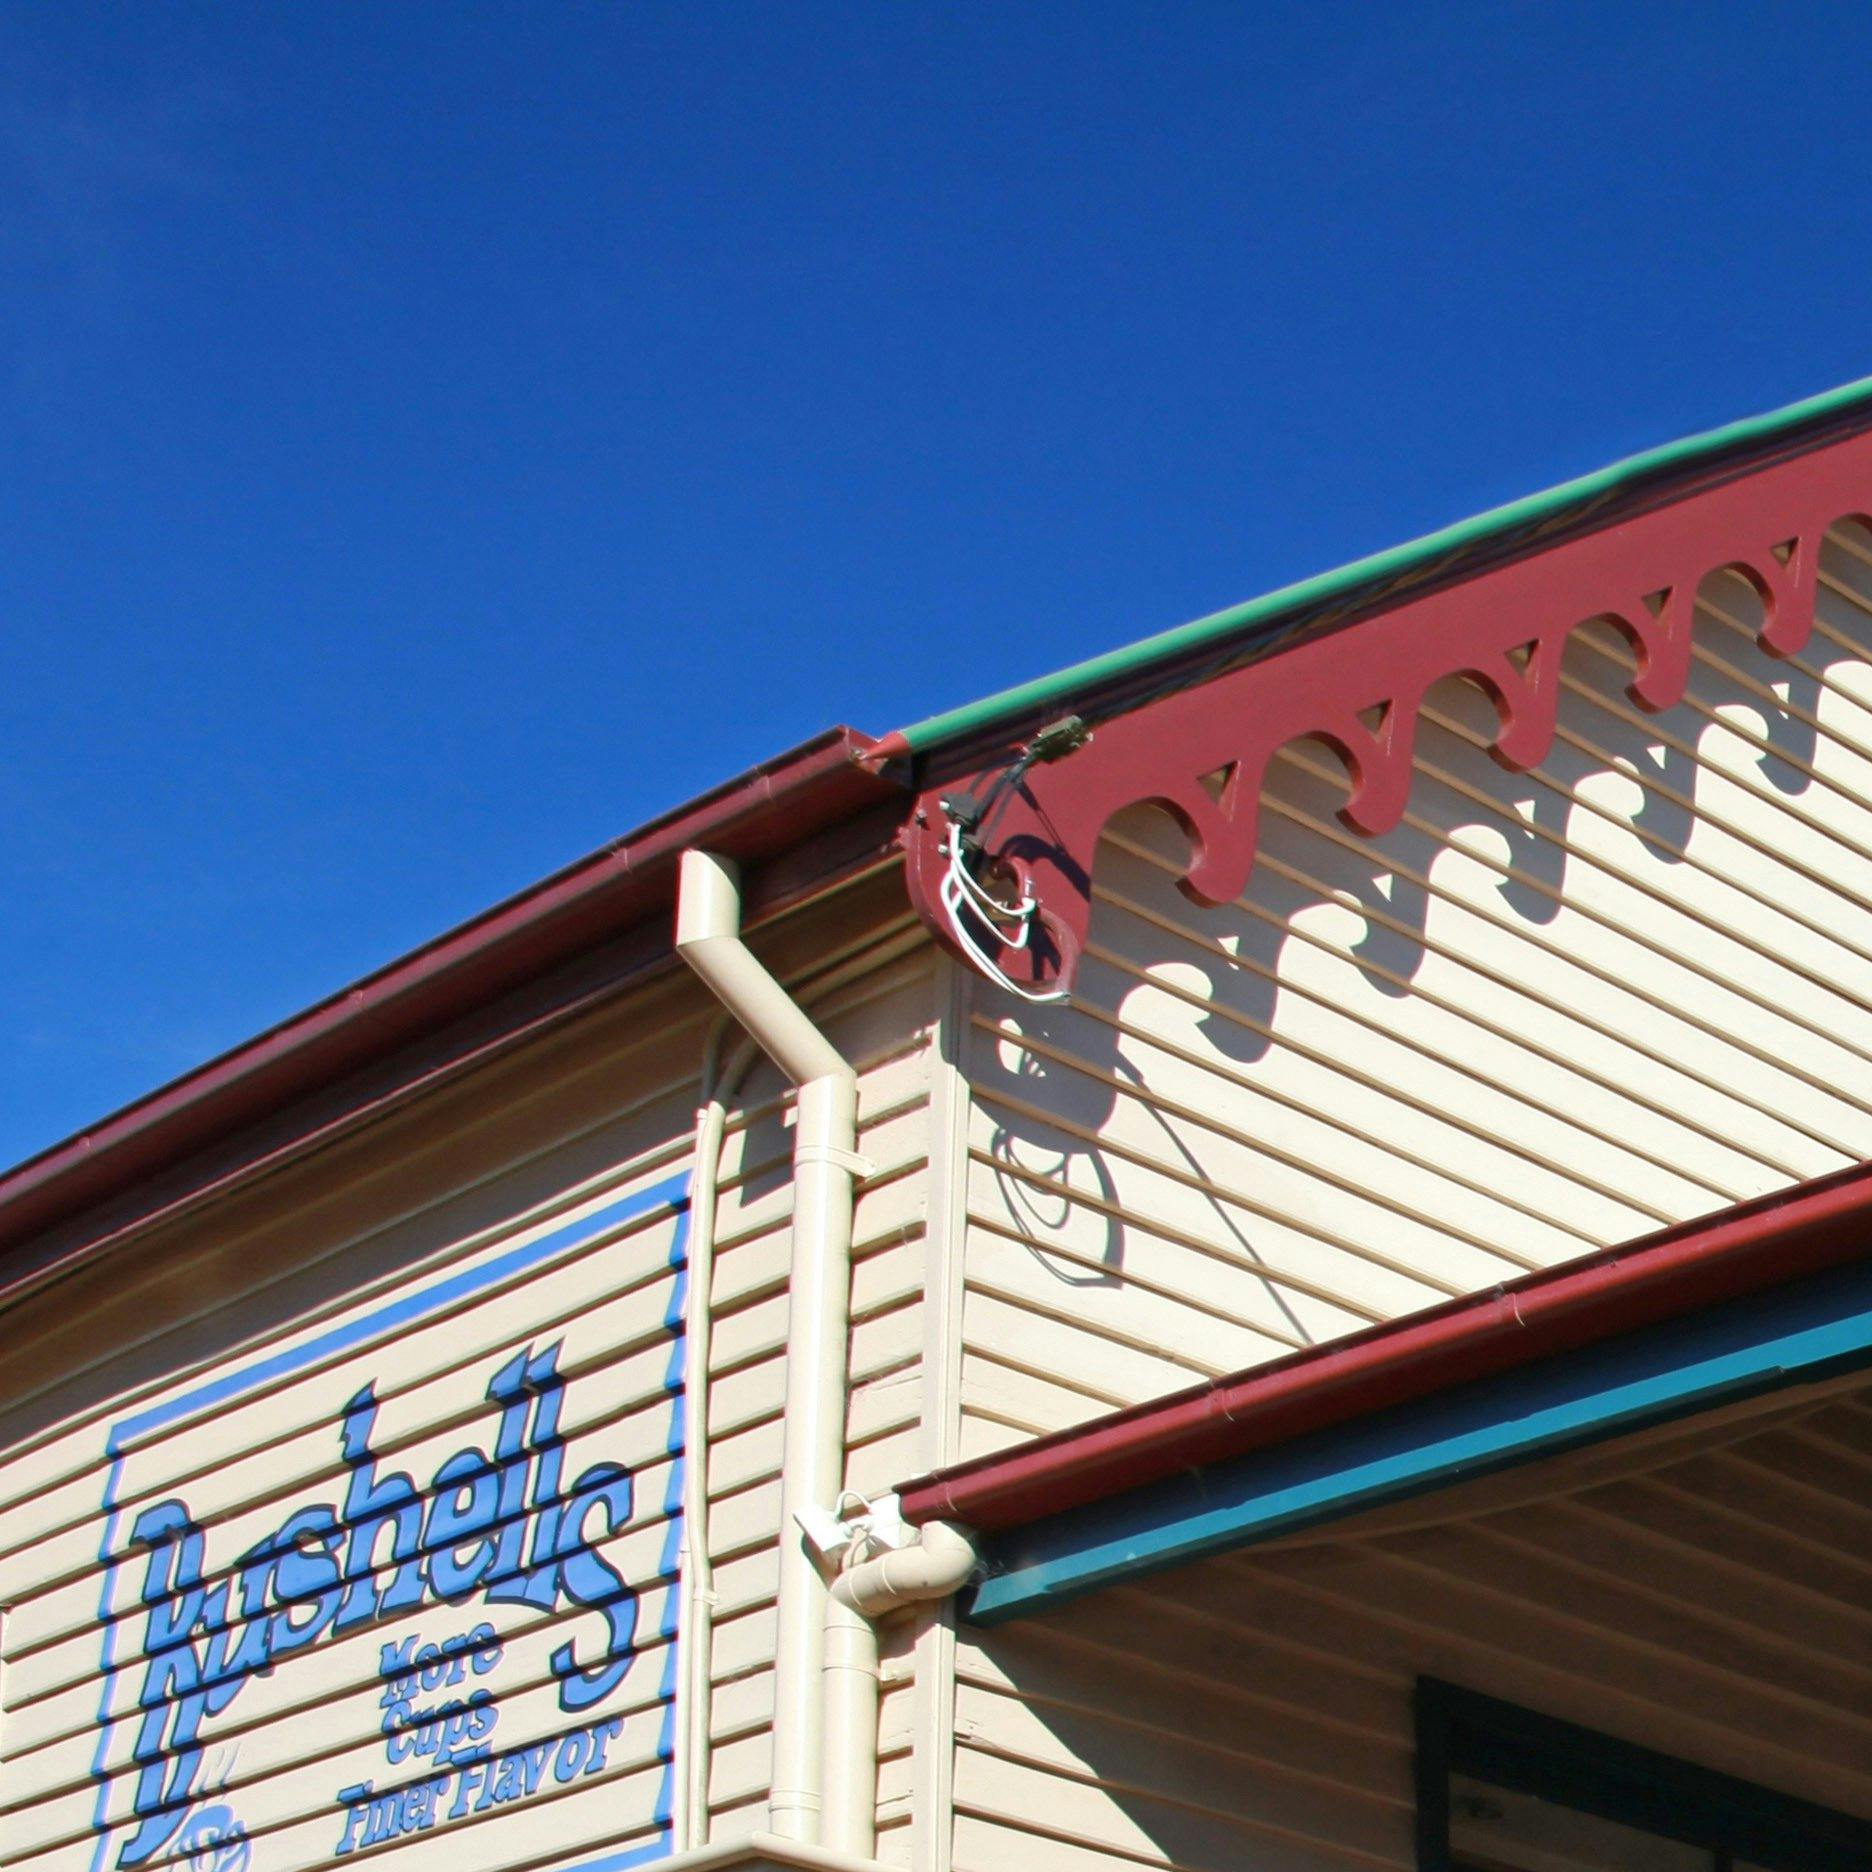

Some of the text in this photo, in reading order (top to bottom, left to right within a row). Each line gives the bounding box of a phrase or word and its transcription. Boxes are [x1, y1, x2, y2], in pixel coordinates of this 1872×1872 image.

[380, 1622, 503, 1708] More
[381, 1688, 499, 1766] Cups
[335, 1718, 624, 1856] Finer Flavor
